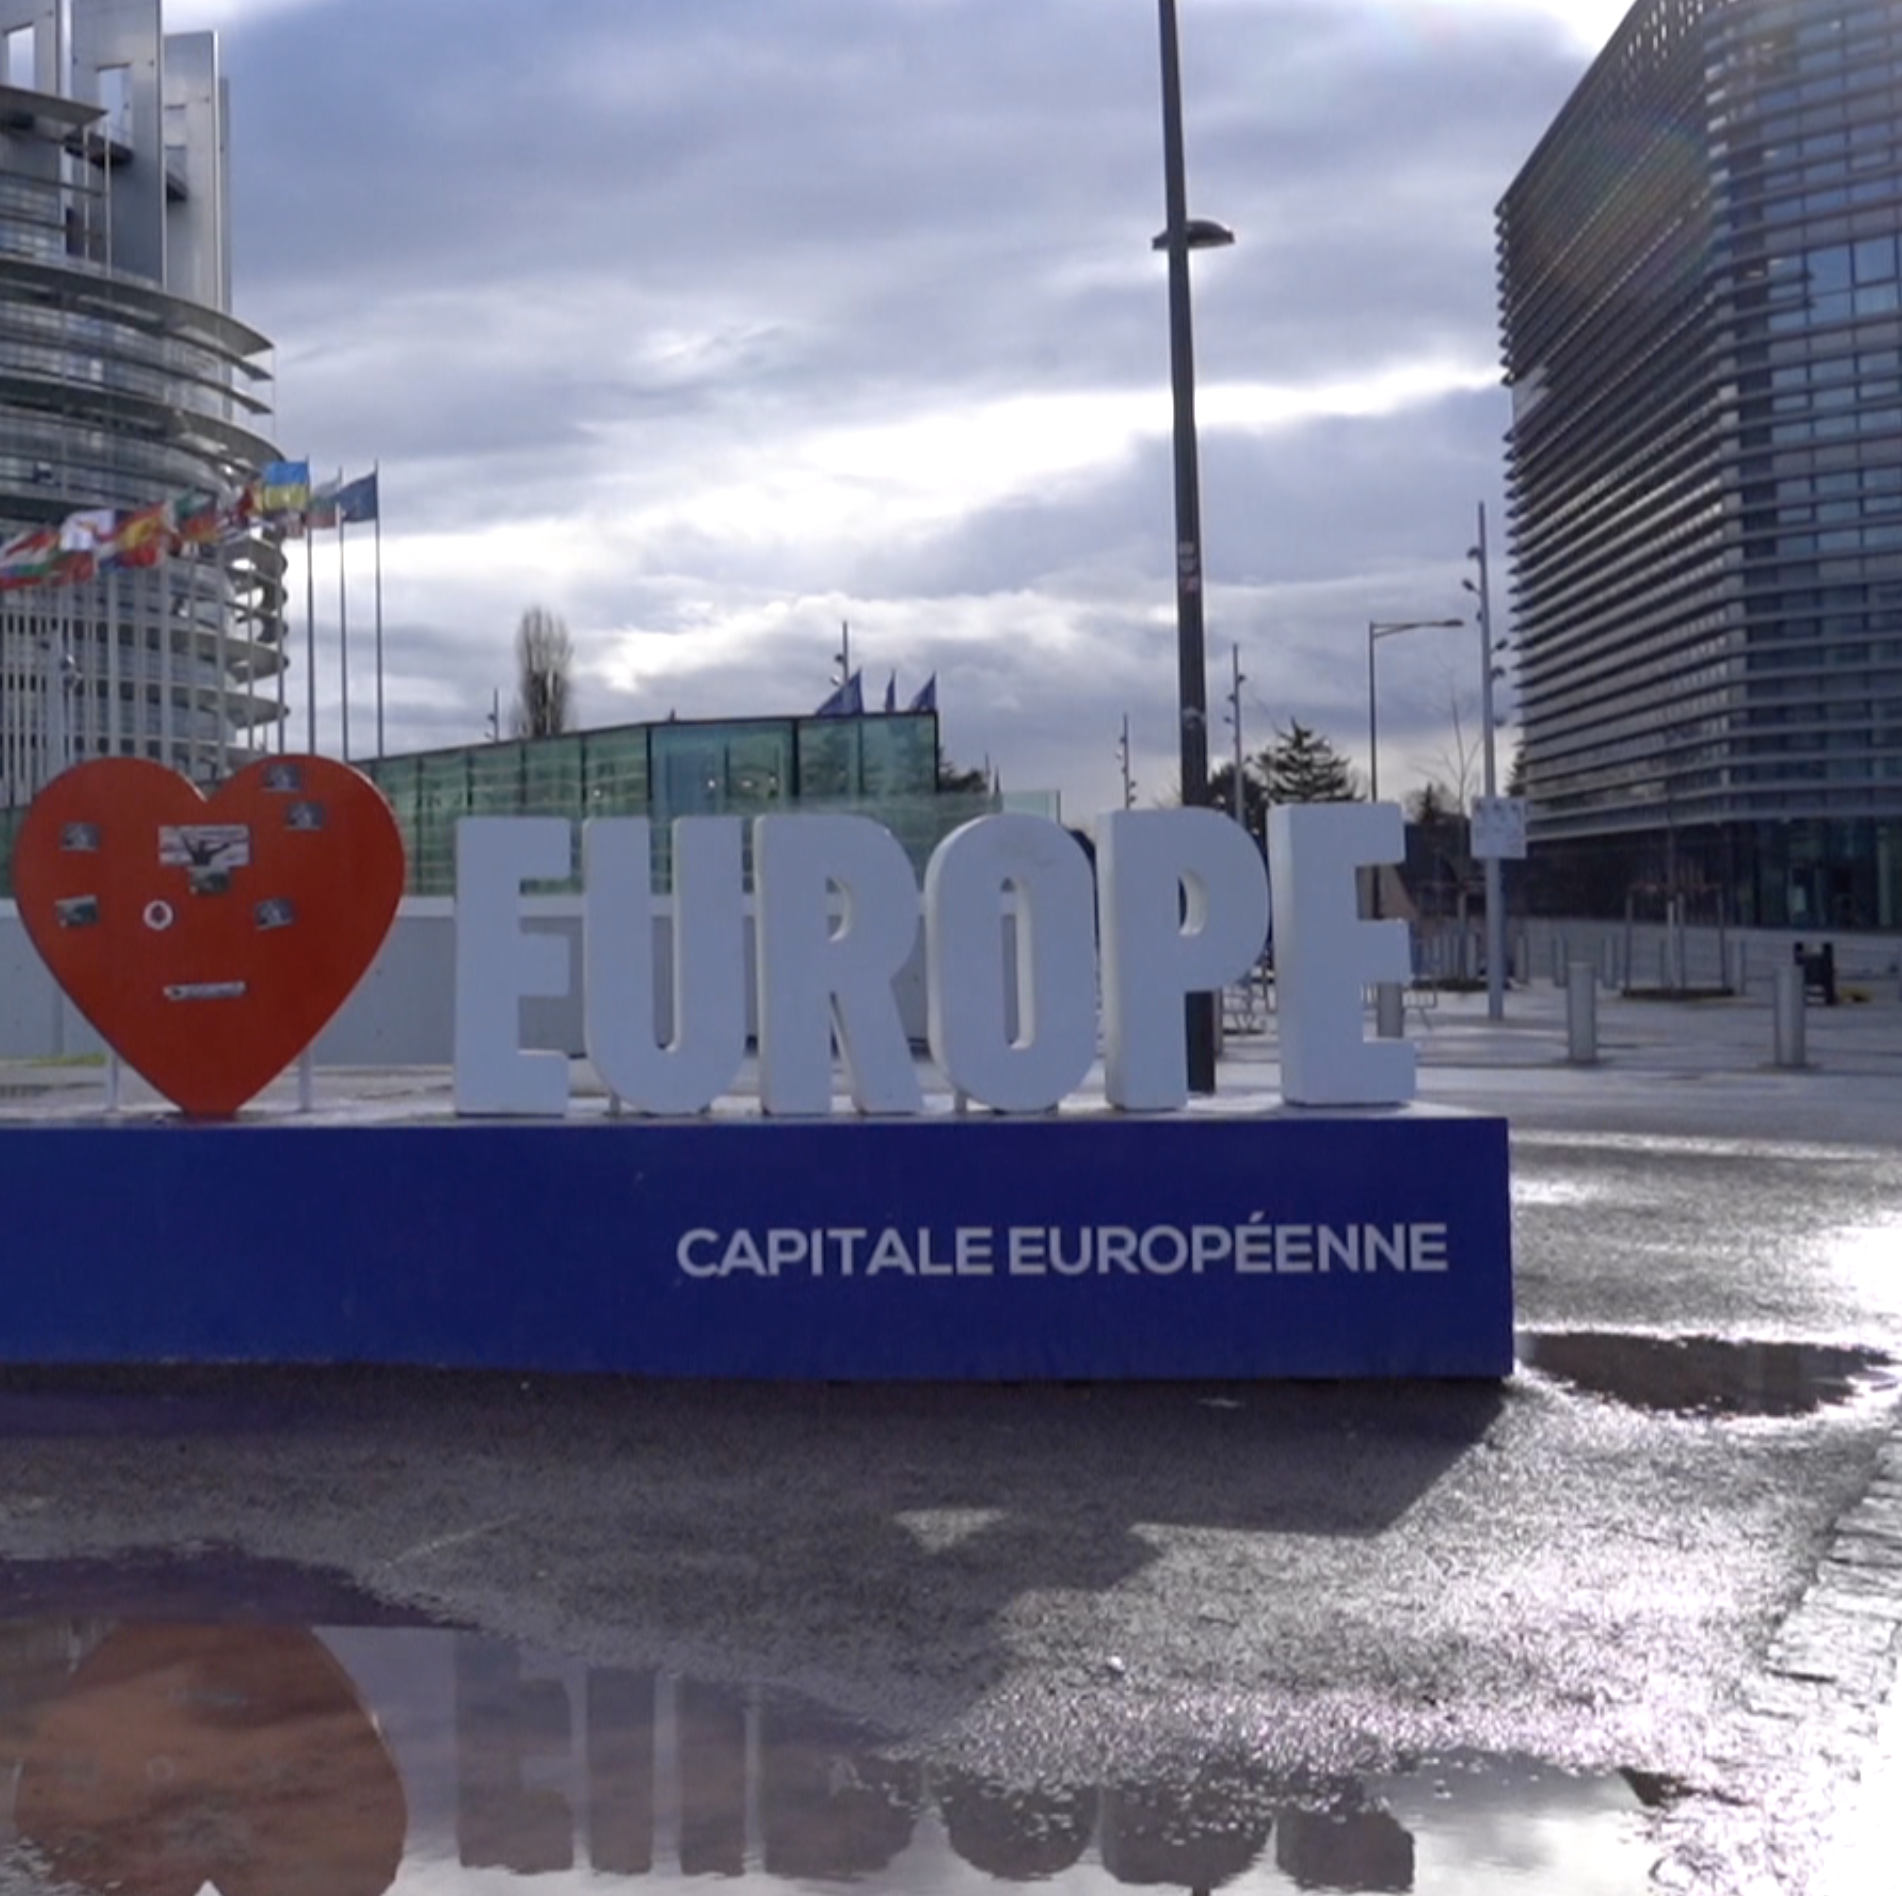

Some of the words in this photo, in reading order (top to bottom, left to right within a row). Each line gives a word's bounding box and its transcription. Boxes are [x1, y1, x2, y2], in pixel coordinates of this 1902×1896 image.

[454, 801, 1417, 1117] EUROPE
[676, 1227, 993, 1278] CAPITALE
[1008, 1211, 1448, 1275] EUROPÉENNE
